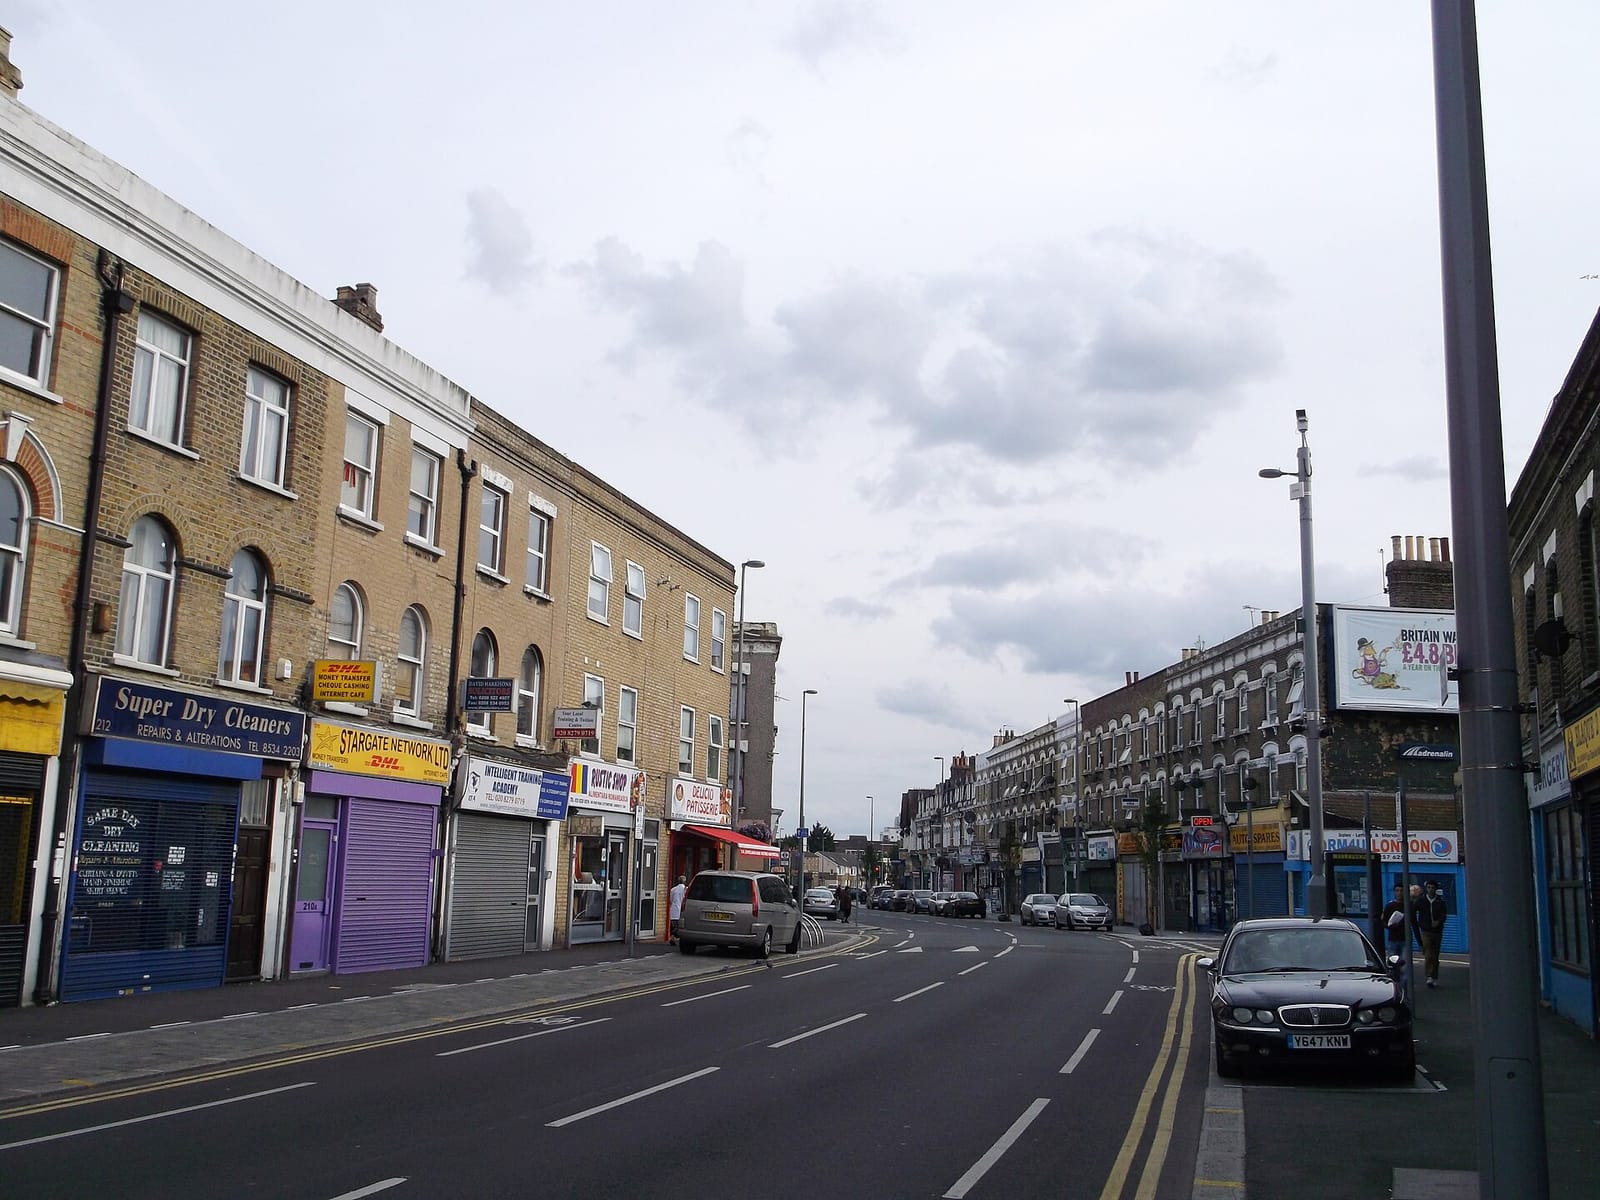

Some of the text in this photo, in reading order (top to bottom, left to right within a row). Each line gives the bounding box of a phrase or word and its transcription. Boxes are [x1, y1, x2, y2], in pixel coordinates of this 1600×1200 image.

[1401, 630, 1440, 642] BRITAIN
[1402, 642, 1439, 664] £4.8
[327, 664, 361, 673] DHL
[115, 687, 292, 735] Super Dry Cleaners
[95, 719, 111, 731] 212
[137, 724, 300, 757] REPAIRS & ALTERATIONS TEL 8534 2203
[312, 752, 326, 761] MONEY
[340, 729, 449, 770] STARGATE NETWORK LTD
[371, 754, 400, 770] DHL
[484, 765, 518, 781] INTELLIGENT
[518, 771, 543, 785] TRAINING
[591, 768, 612, 790] RUSTIC
[612, 772, 627, 792] SHOP
[492, 781, 519, 796] ACADEMY
[692, 785, 714, 801] DELICIO
[686, 799, 719, 816] PATISSERIE
[87, 808, 118, 826] SAME
[1193, 818, 1213, 826] OPEN
[103, 826, 124, 837] DRY
[1253, 831, 1280, 844] SPARES
[82, 840, 140, 852] CLEANING
[1372, 839, 1430, 853] LONON
[1294, 1036, 1349, 1047] Y647 KNW
